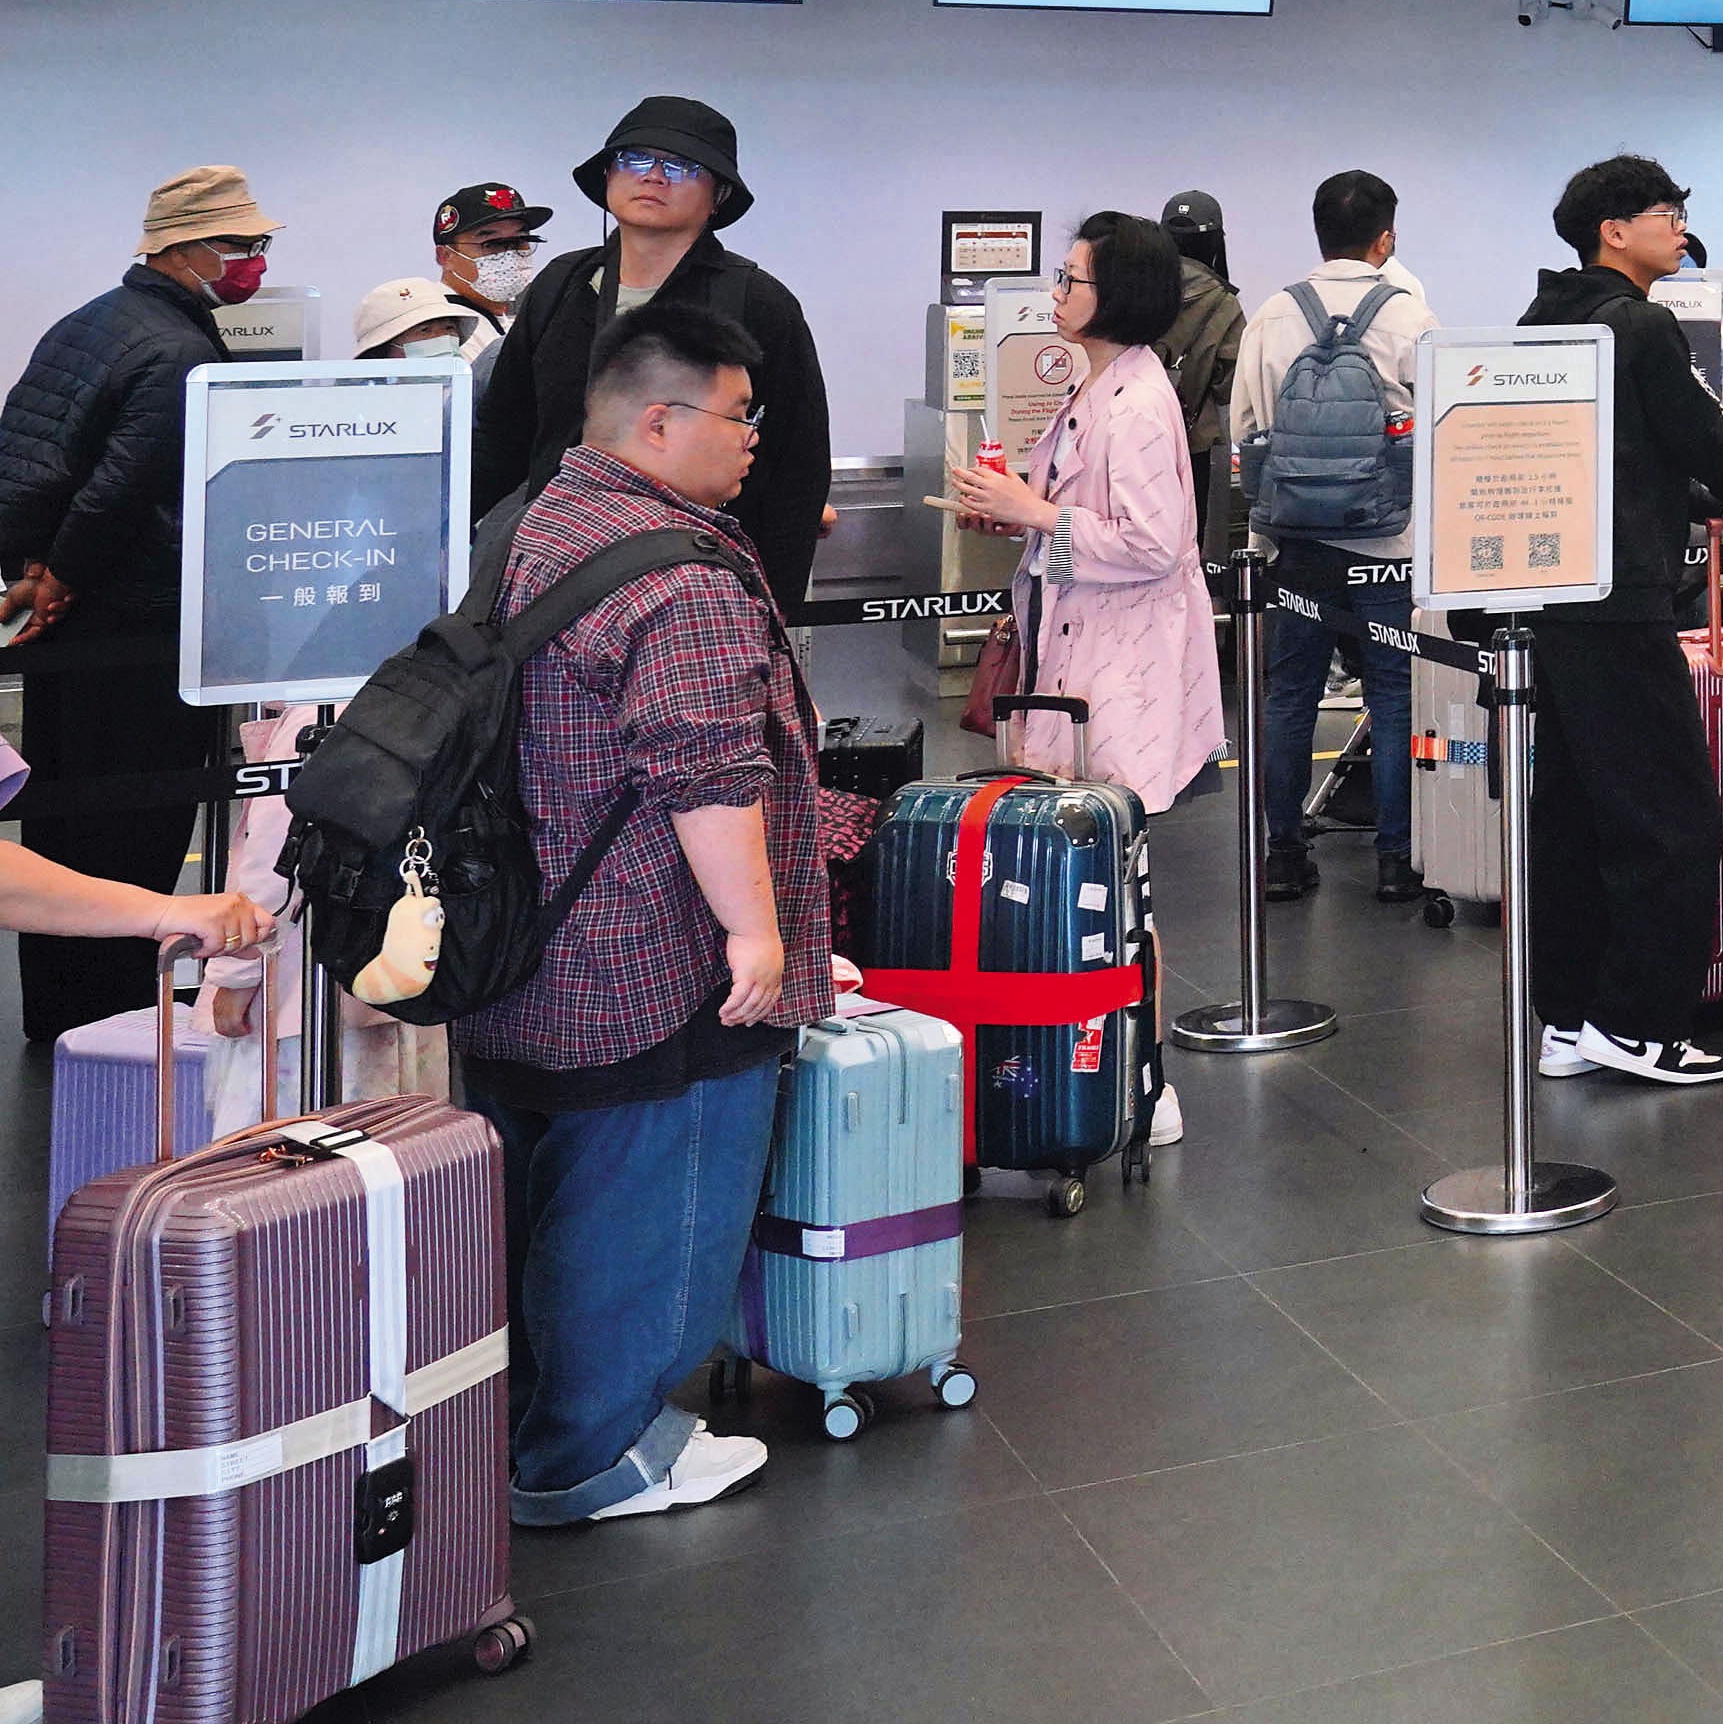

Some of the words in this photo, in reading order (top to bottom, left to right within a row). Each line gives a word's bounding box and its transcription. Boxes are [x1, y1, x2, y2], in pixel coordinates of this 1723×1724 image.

[1494, 372, 1567, 385] STARLUX
[289, 421, 397, 438] STARLUX
[246, 518, 397, 542] GENERAL
[246, 548, 396, 572] CHECK-IN
[260, 582, 381, 606] 一般報到
[862, 592, 1003, 621] STARLUX
[1279, 588, 1323, 622] STARLUX
[1368, 622, 1421, 654] STARLUX
